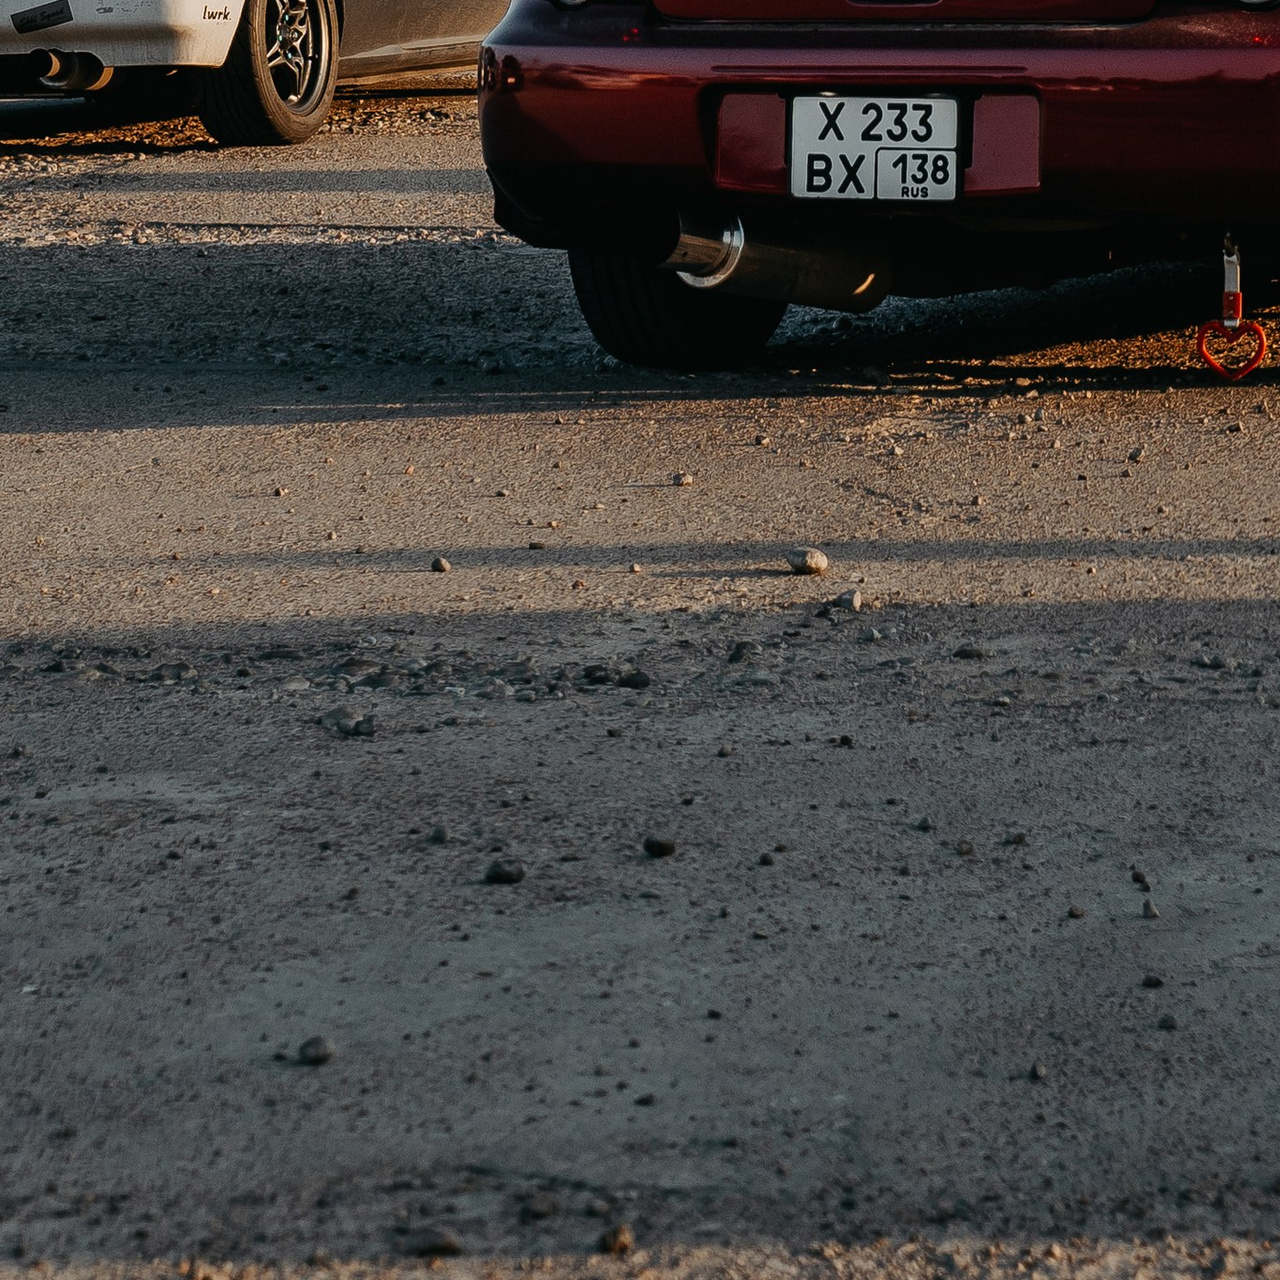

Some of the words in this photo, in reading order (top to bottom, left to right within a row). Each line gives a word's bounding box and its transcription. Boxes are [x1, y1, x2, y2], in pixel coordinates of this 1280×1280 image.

[860, 102, 933, 143] 233
[891, 153, 950, 185] 138
[901, 186, 929, 198] RUS
